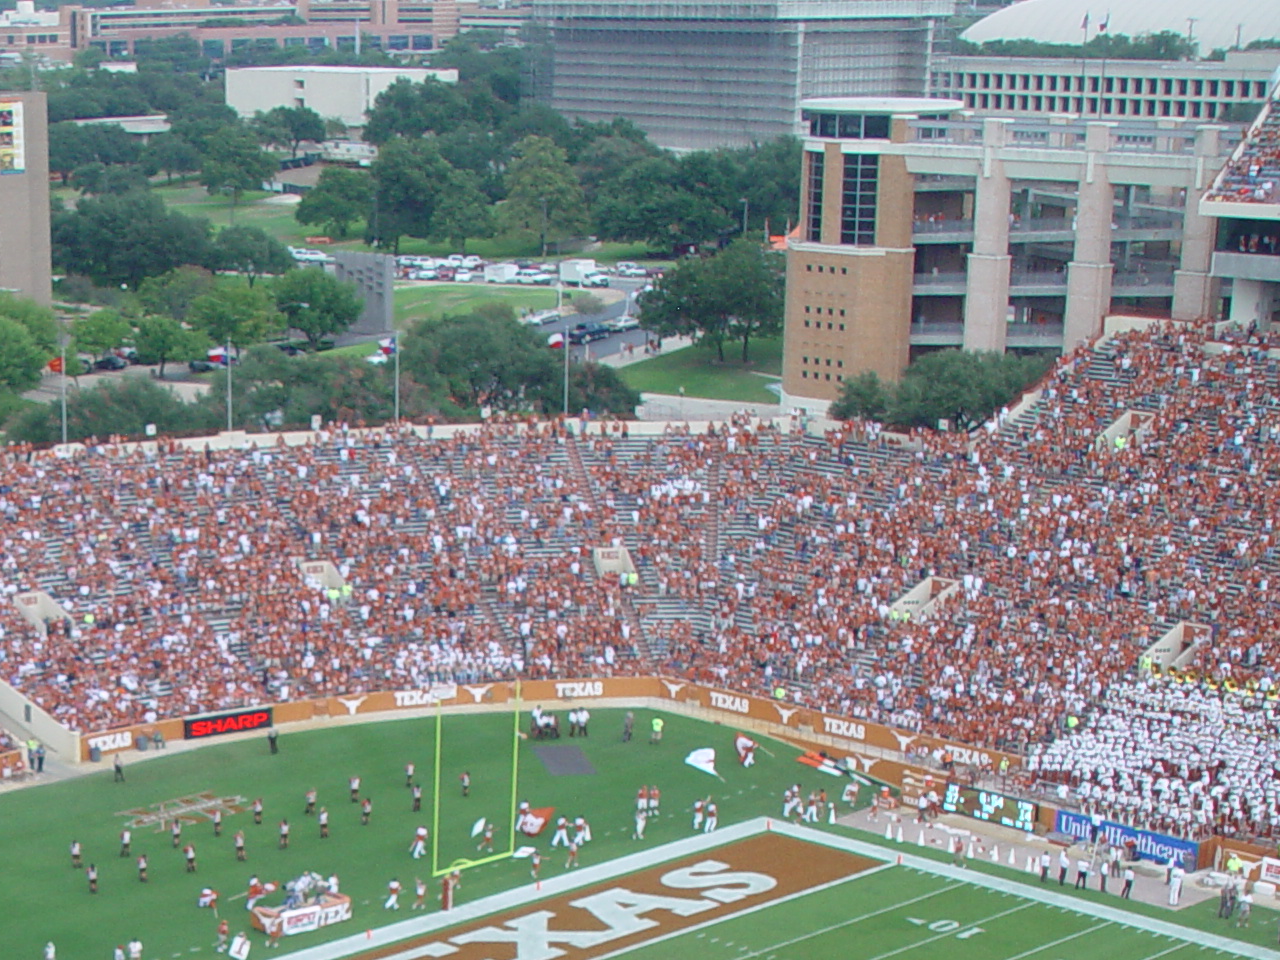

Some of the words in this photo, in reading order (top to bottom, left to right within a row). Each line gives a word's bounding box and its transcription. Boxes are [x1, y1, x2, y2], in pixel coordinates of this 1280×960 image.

[555, 681, 604, 698] TEXAS
[709, 691, 750, 713] TEXAS
[191, 712, 269, 737] SHARP
[823, 716, 866, 739] TEXAS
